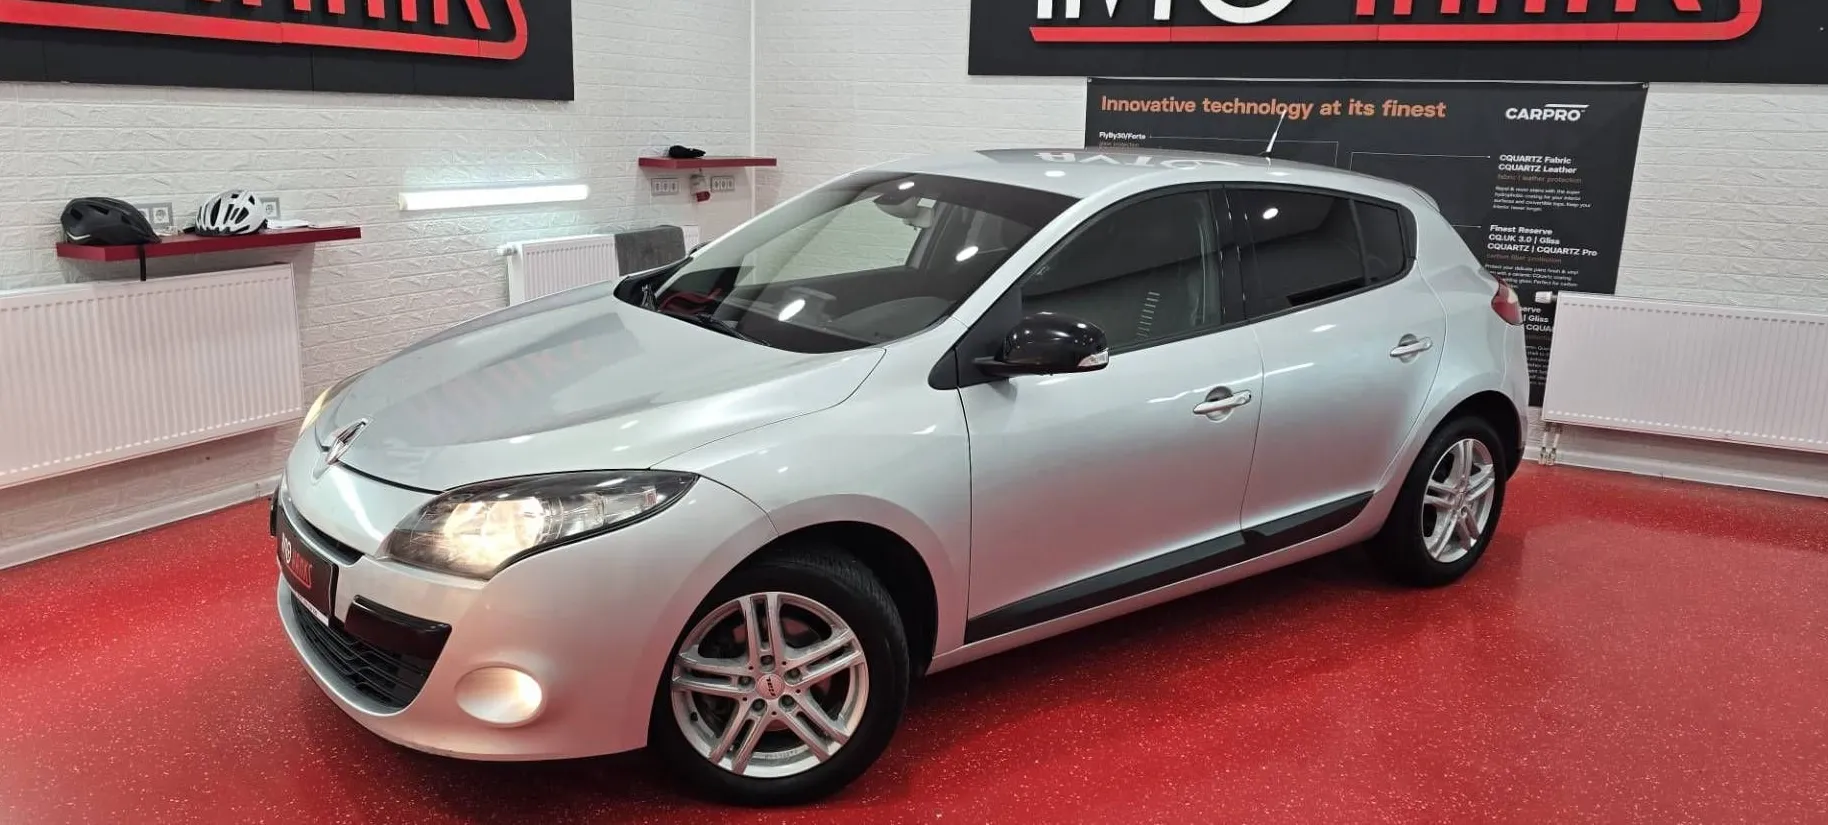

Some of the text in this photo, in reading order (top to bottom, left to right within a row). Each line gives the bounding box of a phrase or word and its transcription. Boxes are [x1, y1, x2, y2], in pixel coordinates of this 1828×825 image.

[1101, 96, 1447, 120] Innovative technology at its finest
[1505, 106, 1582, 122] CARPRO
[1499, 154, 1571, 165] CQUARTZ Fabric
[1498, 163, 1577, 174] CQUARTZ Leather
[1489, 224, 1553, 236] Finest Reserve
[1518, 235, 1532, 243] 3.0
[1539, 236, 1560, 245] Gliss
[1487, 242, 1530, 253] CQUARTZ
[1537, 246, 1580, 256] CQUARTZ
[1582, 248, 1598, 257] Pro
[1528, 314, 1549, 323] Gliss
[1526, 323, 1553, 333] CQUA
